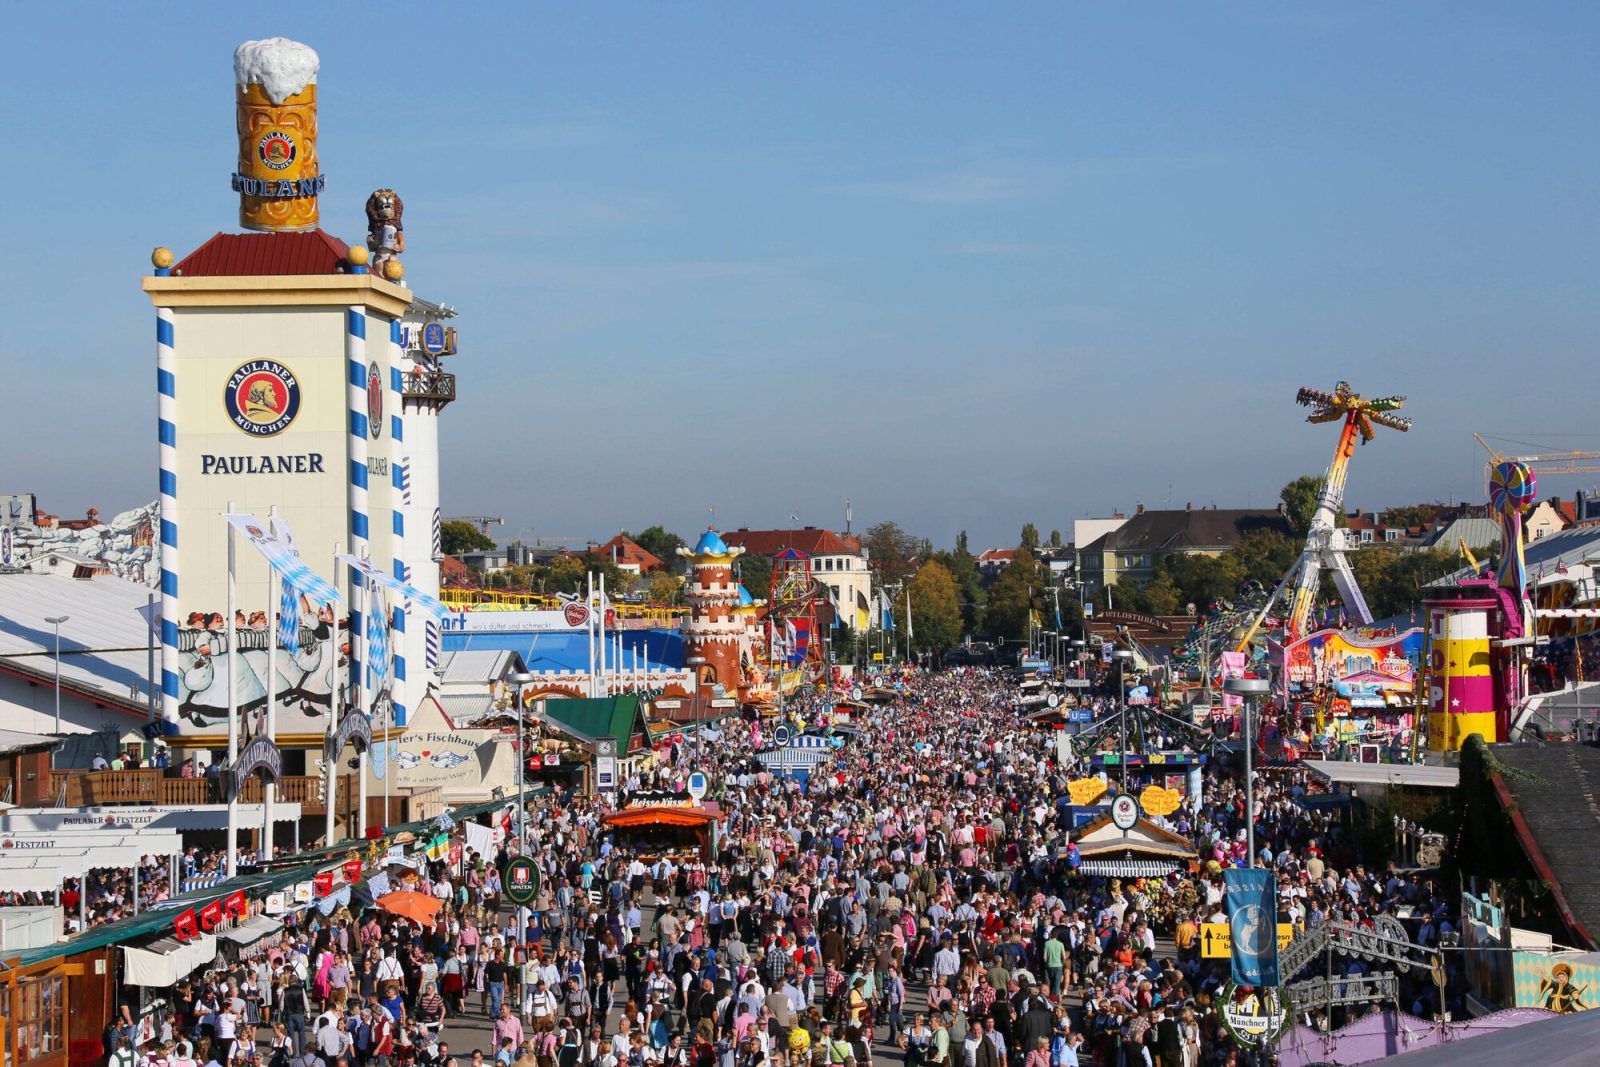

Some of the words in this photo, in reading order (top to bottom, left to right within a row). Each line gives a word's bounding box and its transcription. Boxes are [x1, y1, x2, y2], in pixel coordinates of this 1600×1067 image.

[260, 132, 295, 148] PAULANER
[263, 158, 293, 170] MÜNCHEN
[228, 361, 296, 390] PAULANER
[234, 414, 291, 434] MÜNCHEN
[201, 453, 325, 475] PAULANER
[441, 613, 467, 630] art
[508, 621, 521, 630] und
[522, 621, 552, 630] schmeckt
[1105, 611, 1160, 627] WILDSTUBEN
[398, 733, 423, 744] ter's
[427, 732, 480, 749] Fischhaus
[632, 798, 660, 807] Heisse
[63, 816, 104, 825] PAULANER
[116, 815, 153, 824] FESTZELT
[15, 840, 56, 849] FESTZELT
[1216, 932, 1230, 941] Zug
[1230, 1016, 1266, 1027] Münchner
